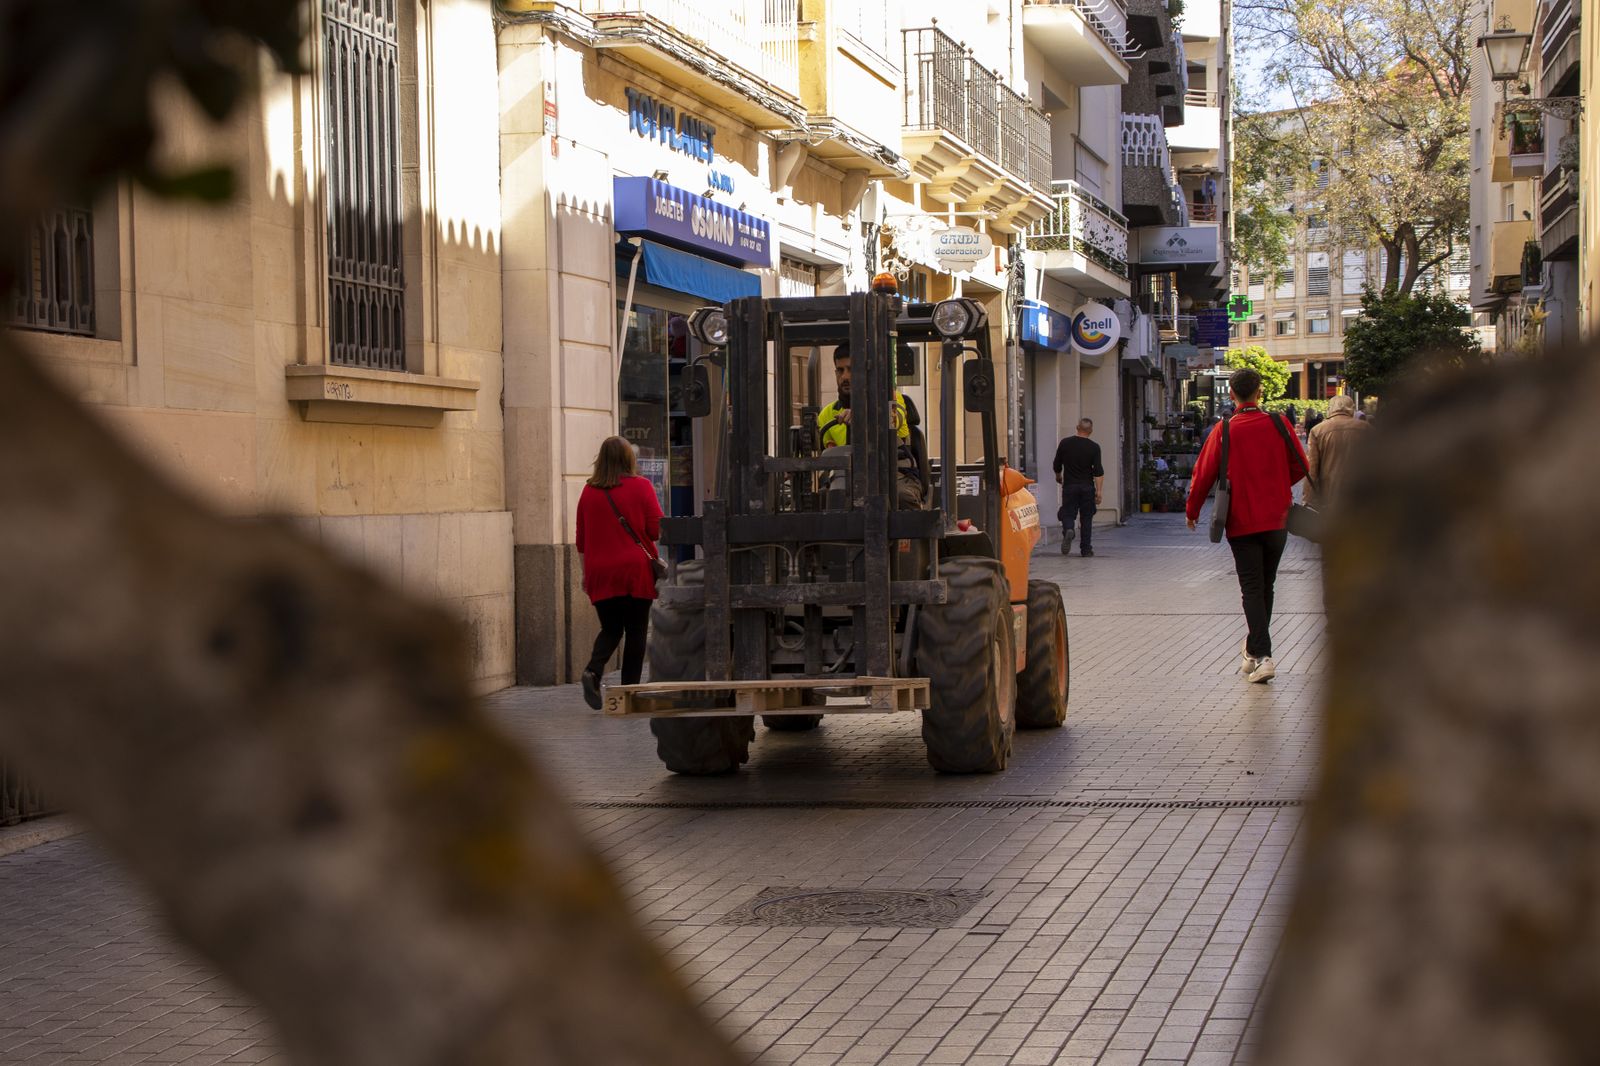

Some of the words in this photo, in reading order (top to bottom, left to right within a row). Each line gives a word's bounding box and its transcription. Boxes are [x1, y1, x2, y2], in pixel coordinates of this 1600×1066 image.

[624, 86, 659, 141] TOY
[659, 103, 716, 165] PLANET
[655, 196, 684, 222] JUGUETES
[691, 203, 735, 247] OSORNO
[934, 247, 983, 255] decoración
[1083, 317, 1112, 330] Snell
[623, 427, 651, 440] CITY
